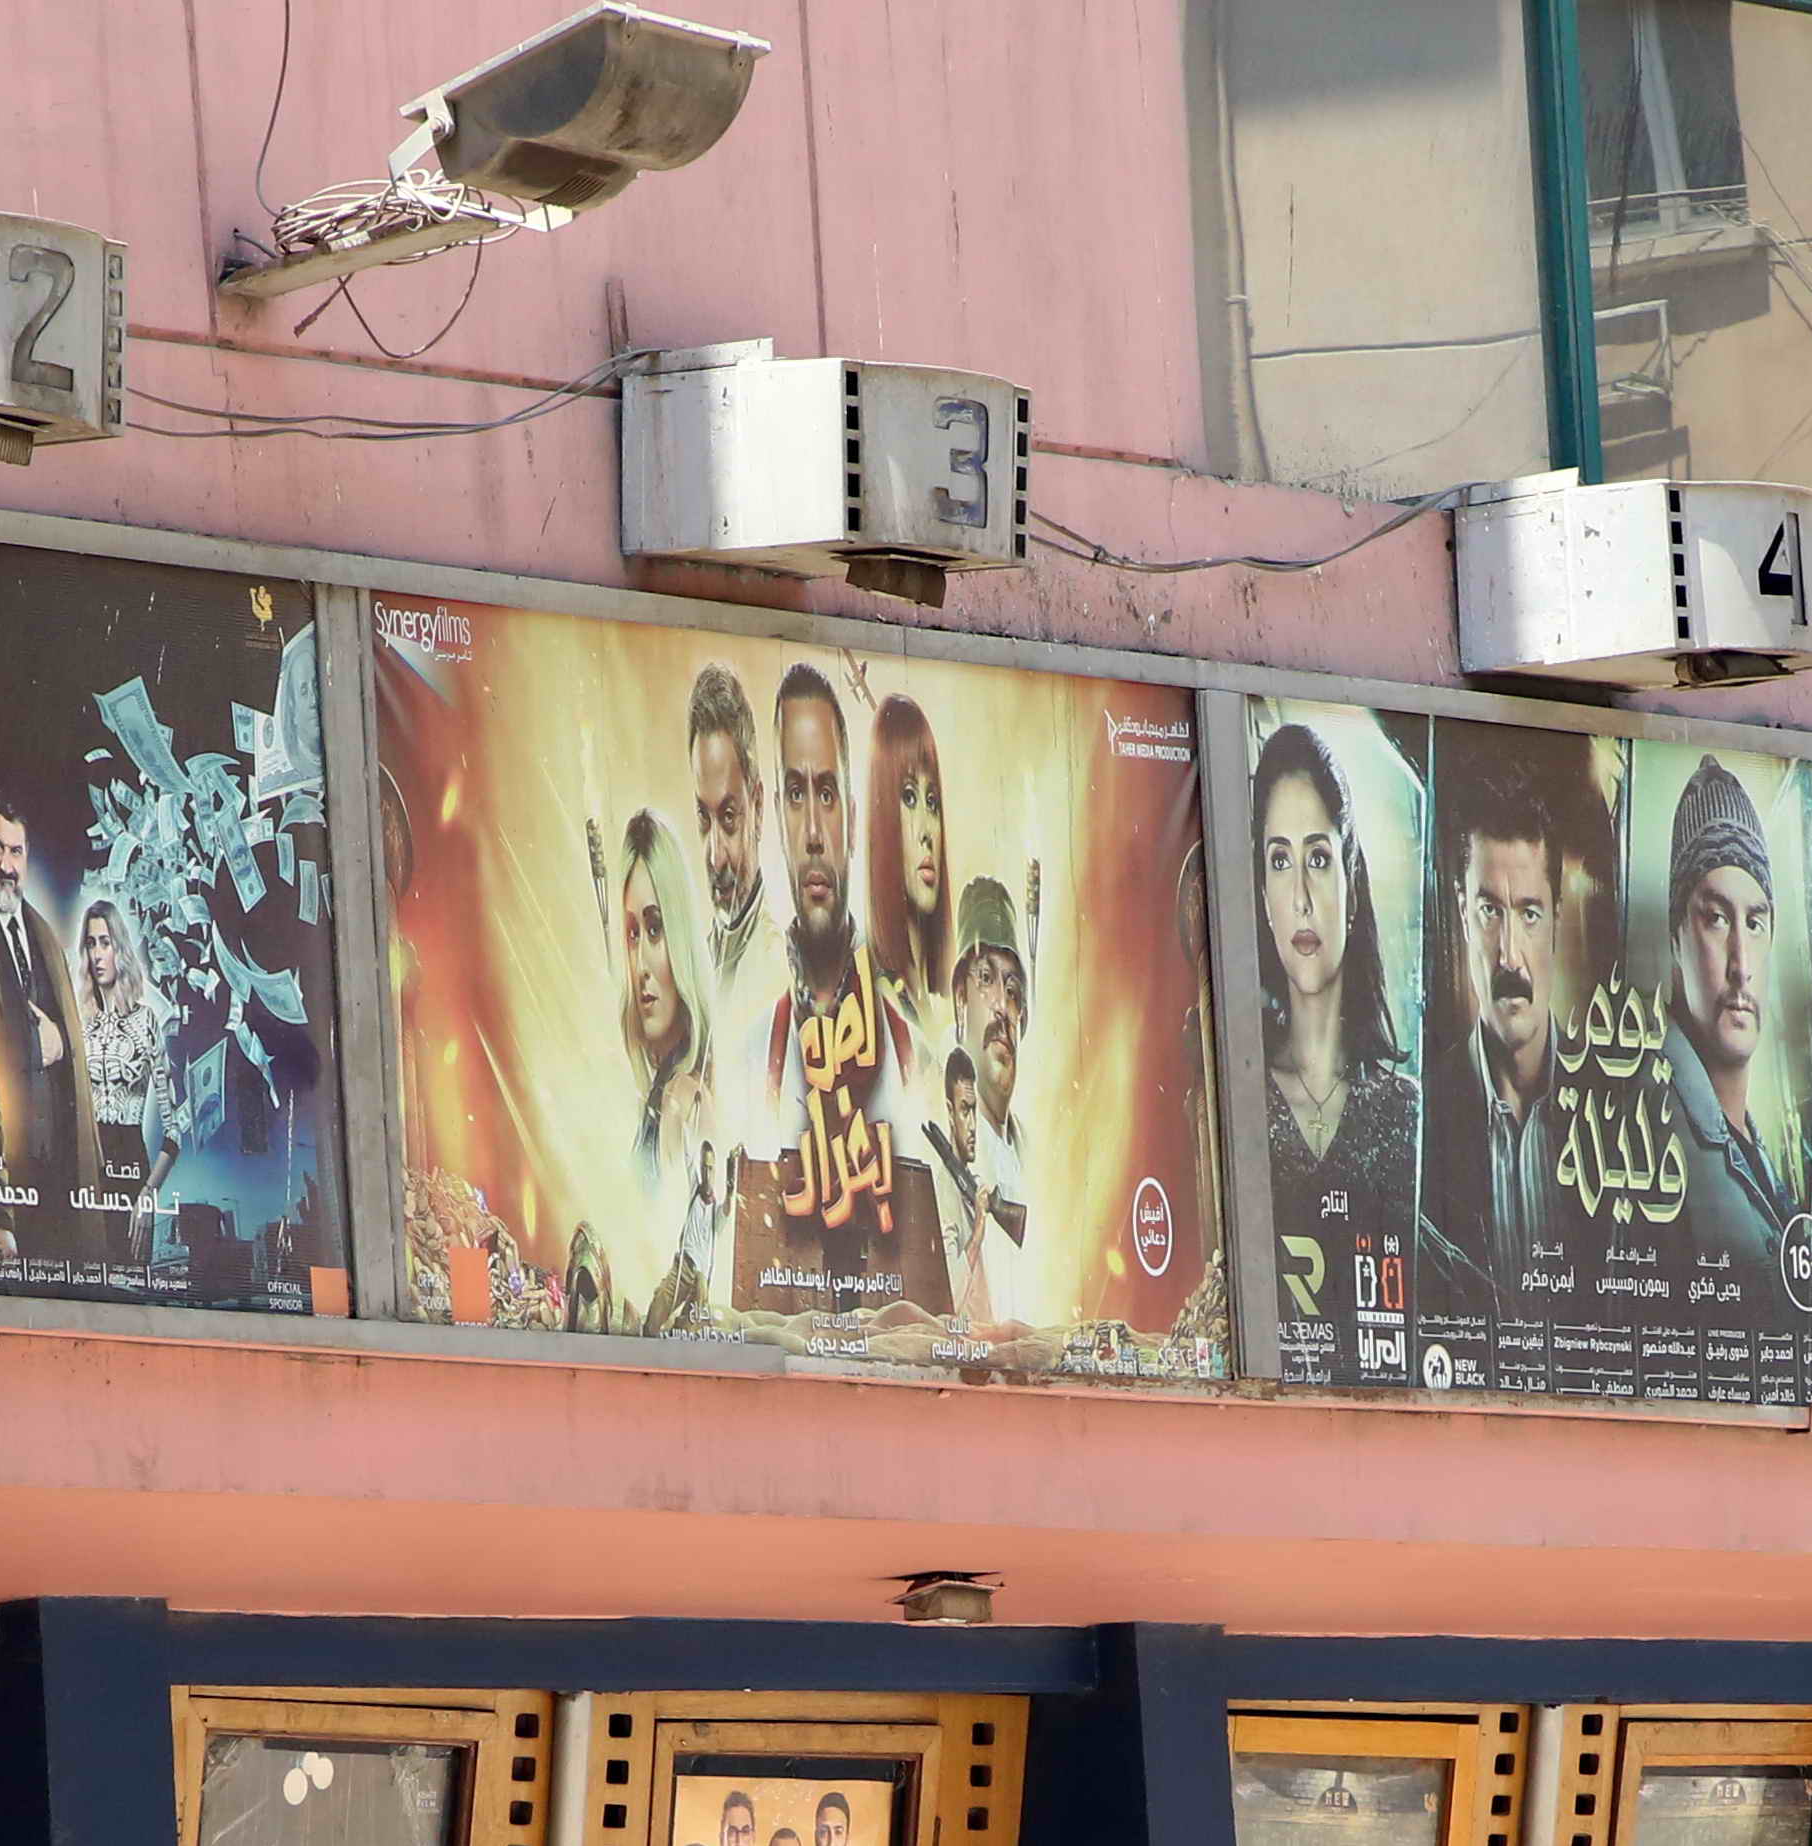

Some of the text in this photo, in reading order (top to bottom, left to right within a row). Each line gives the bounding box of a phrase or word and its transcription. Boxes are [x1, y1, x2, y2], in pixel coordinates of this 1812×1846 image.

[8, 244, 75, 393] 2
[934, 398, 987, 529] 3
[1758, 512, 1808, 626] 4
[1557, 960, 1674, 1080] يوم
[105, 1160, 141, 1181] قصة
[133, 1190, 181, 1217] تامر
[1555, 1082, 1690, 1224] وليلة
[1455, 1359, 1478, 1371] NEW
[1455, 1371, 1485, 1386] BLACK
